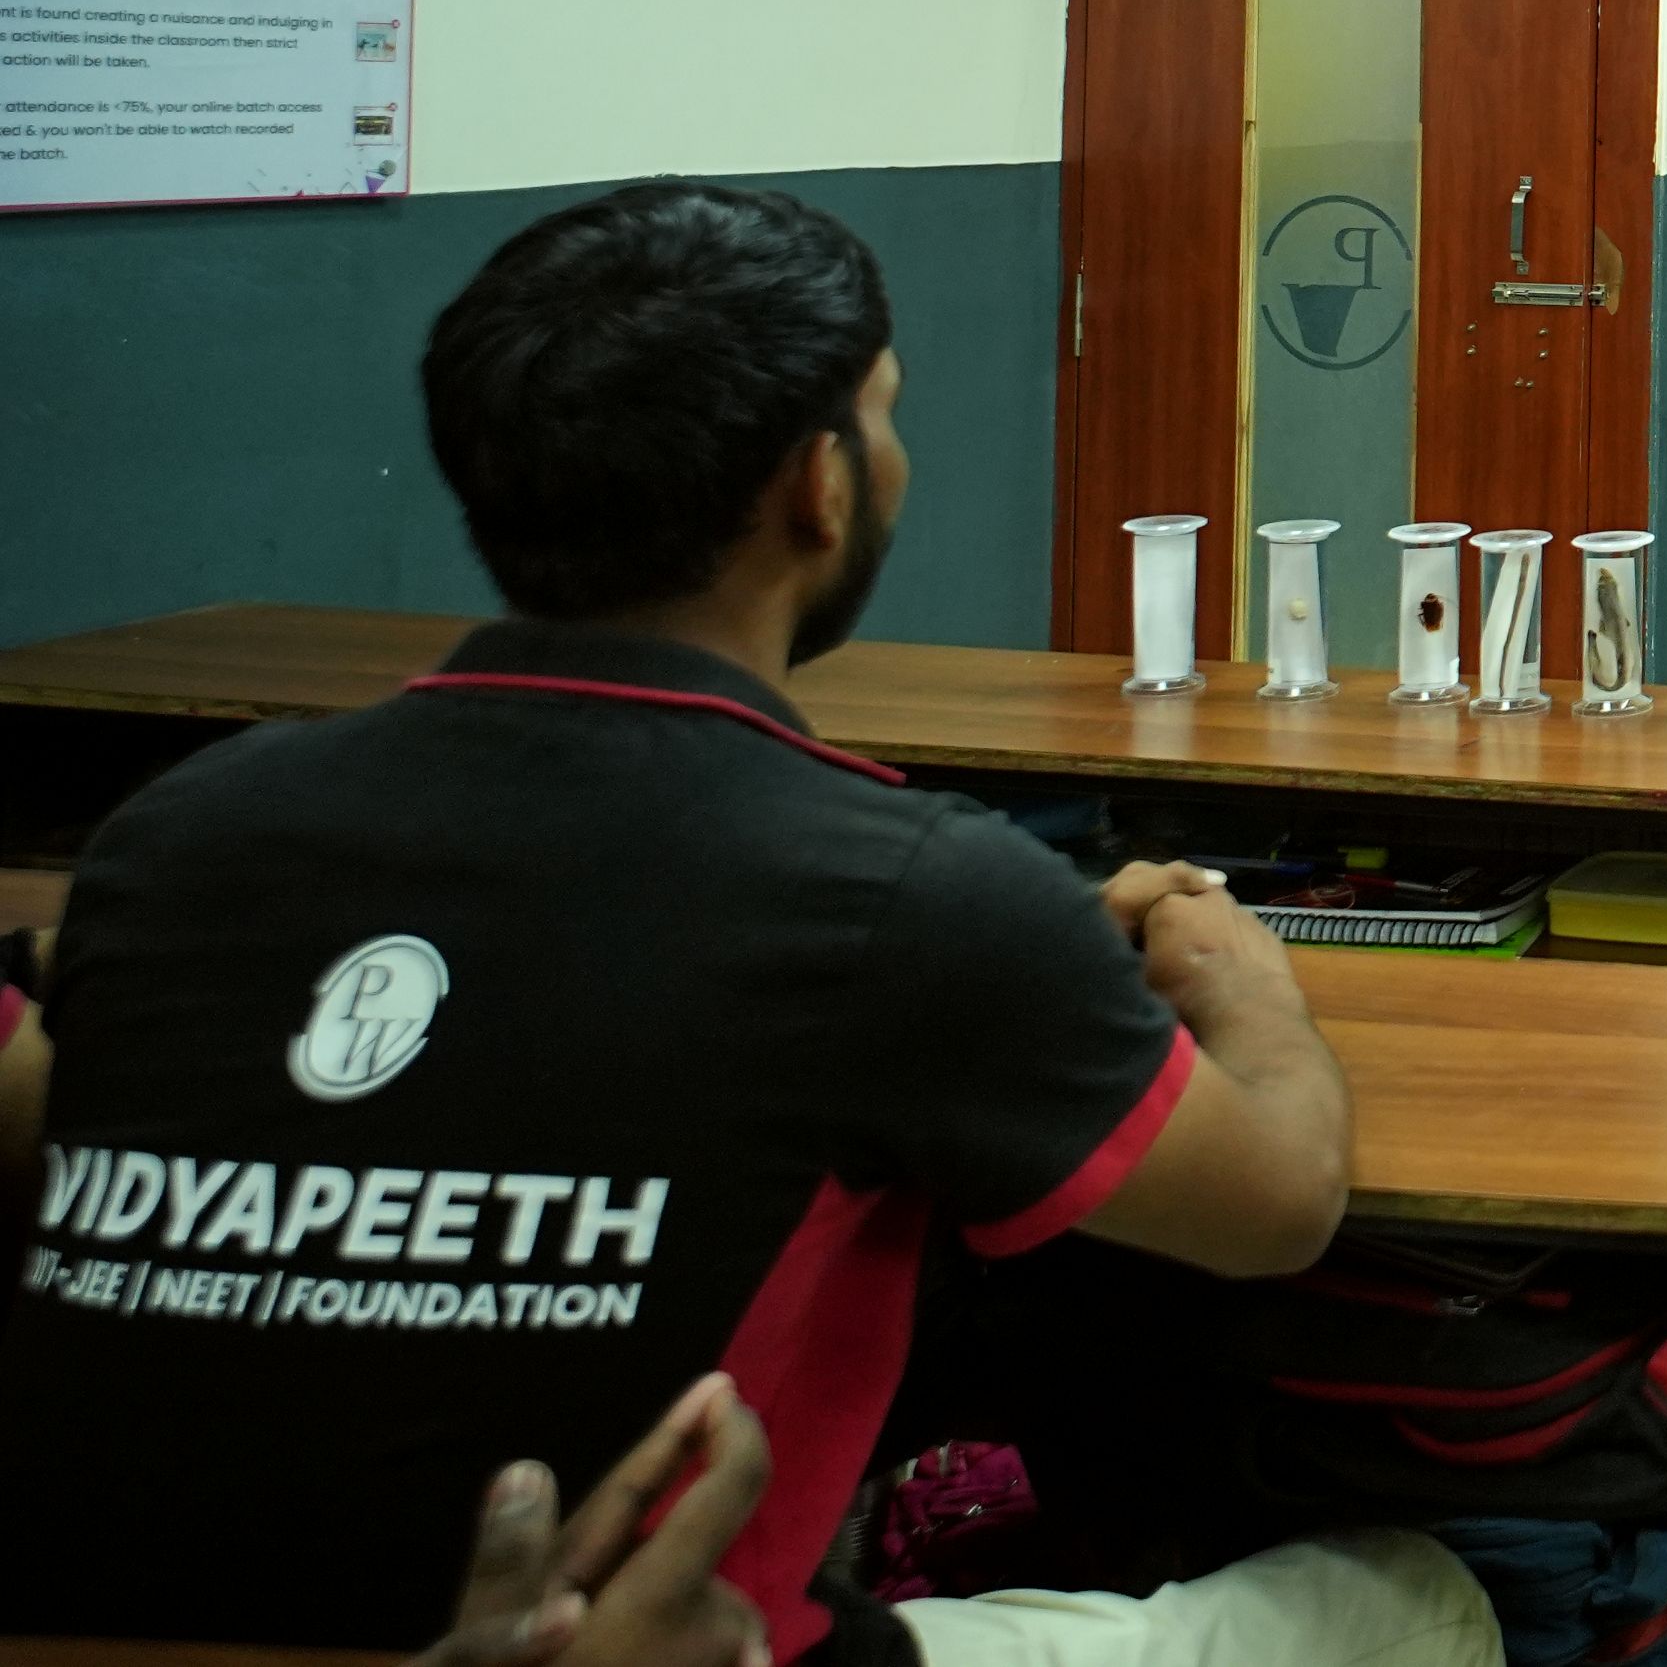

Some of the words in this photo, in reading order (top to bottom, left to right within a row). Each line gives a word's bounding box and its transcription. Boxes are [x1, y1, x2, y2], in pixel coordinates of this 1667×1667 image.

[6, 101, 94, 113] attendance
[98, 101, 110, 113] is
[158, 103, 189, 116] your
[192, 101, 232, 113] online
[236, 101, 274, 113] batch
[278, 103, 323, 113] access
[42, 1143, 669, 1264] VIDYAPEETH
[148, 1268, 262, 1320] NEET
[276, 1275, 643, 1327] FOUNDATION
